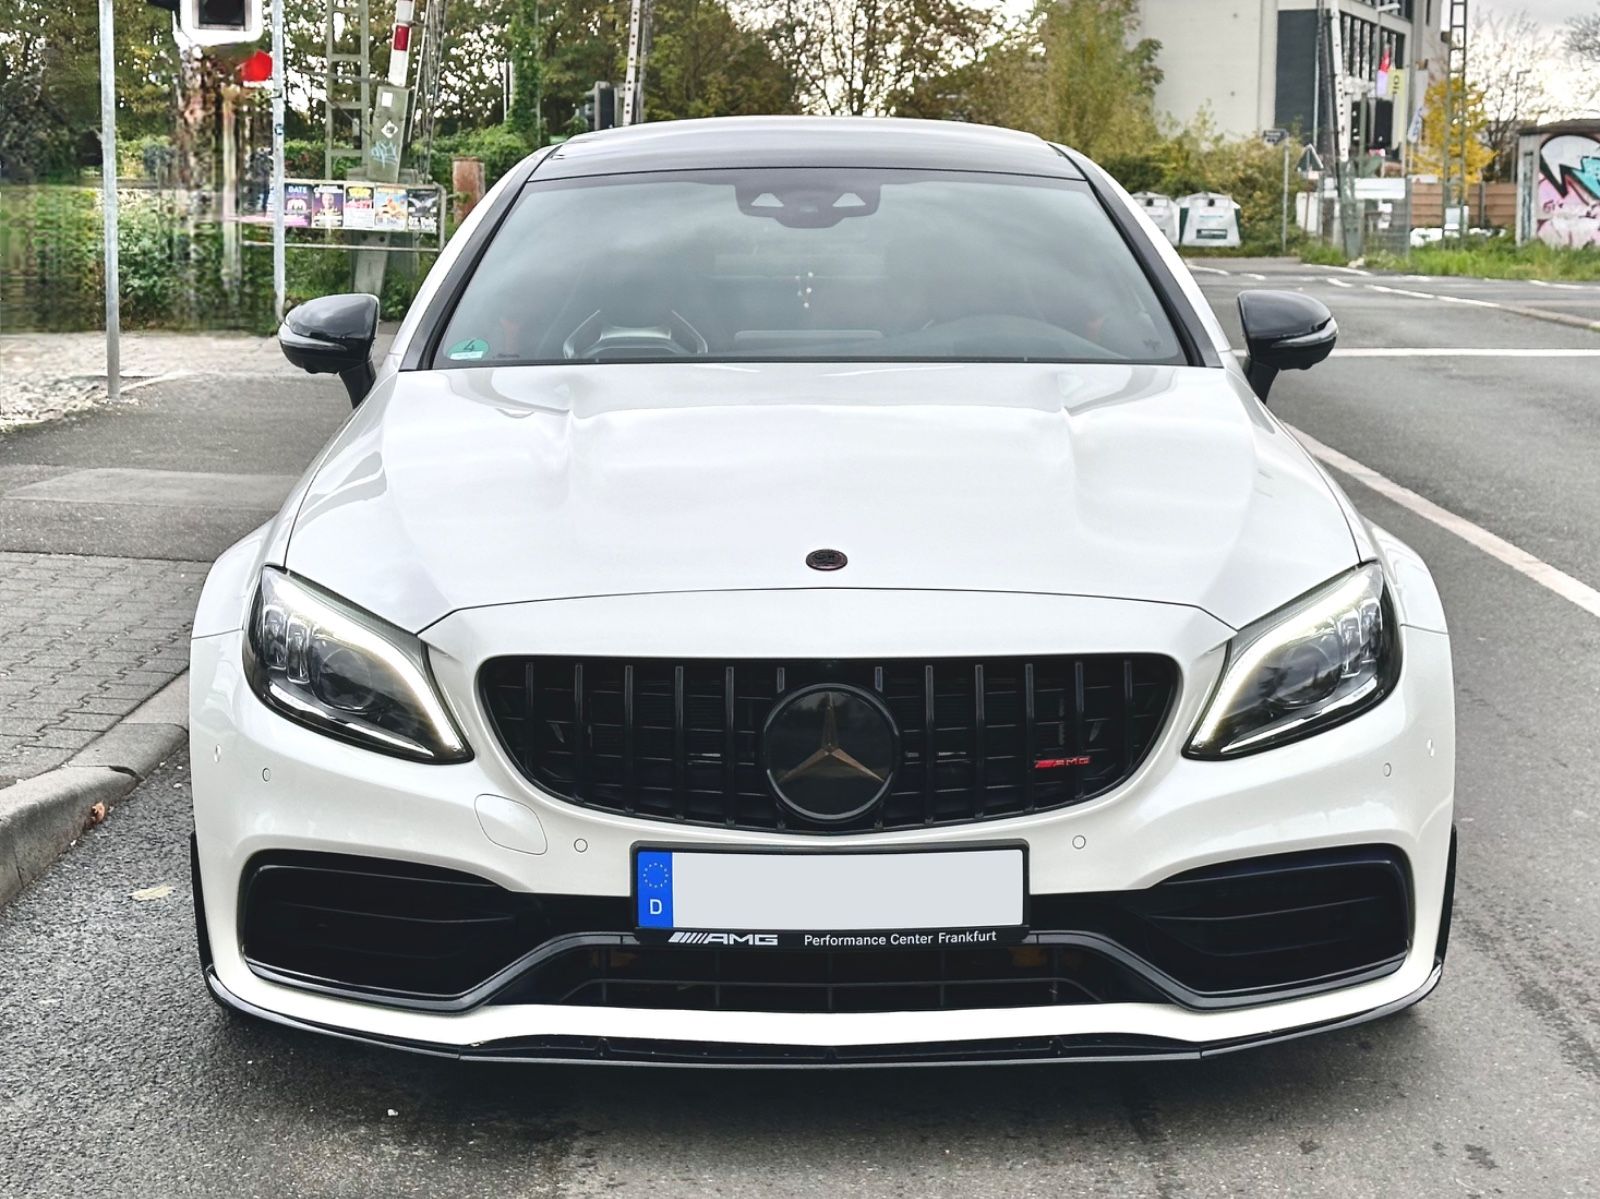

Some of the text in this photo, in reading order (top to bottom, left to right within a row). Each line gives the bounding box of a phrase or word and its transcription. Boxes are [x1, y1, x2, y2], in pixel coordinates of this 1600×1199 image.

[649, 898, 662, 915] D
[702, 933, 778, 945] AMG
[804, 930, 997, 946] Performance Center Frankfurt
